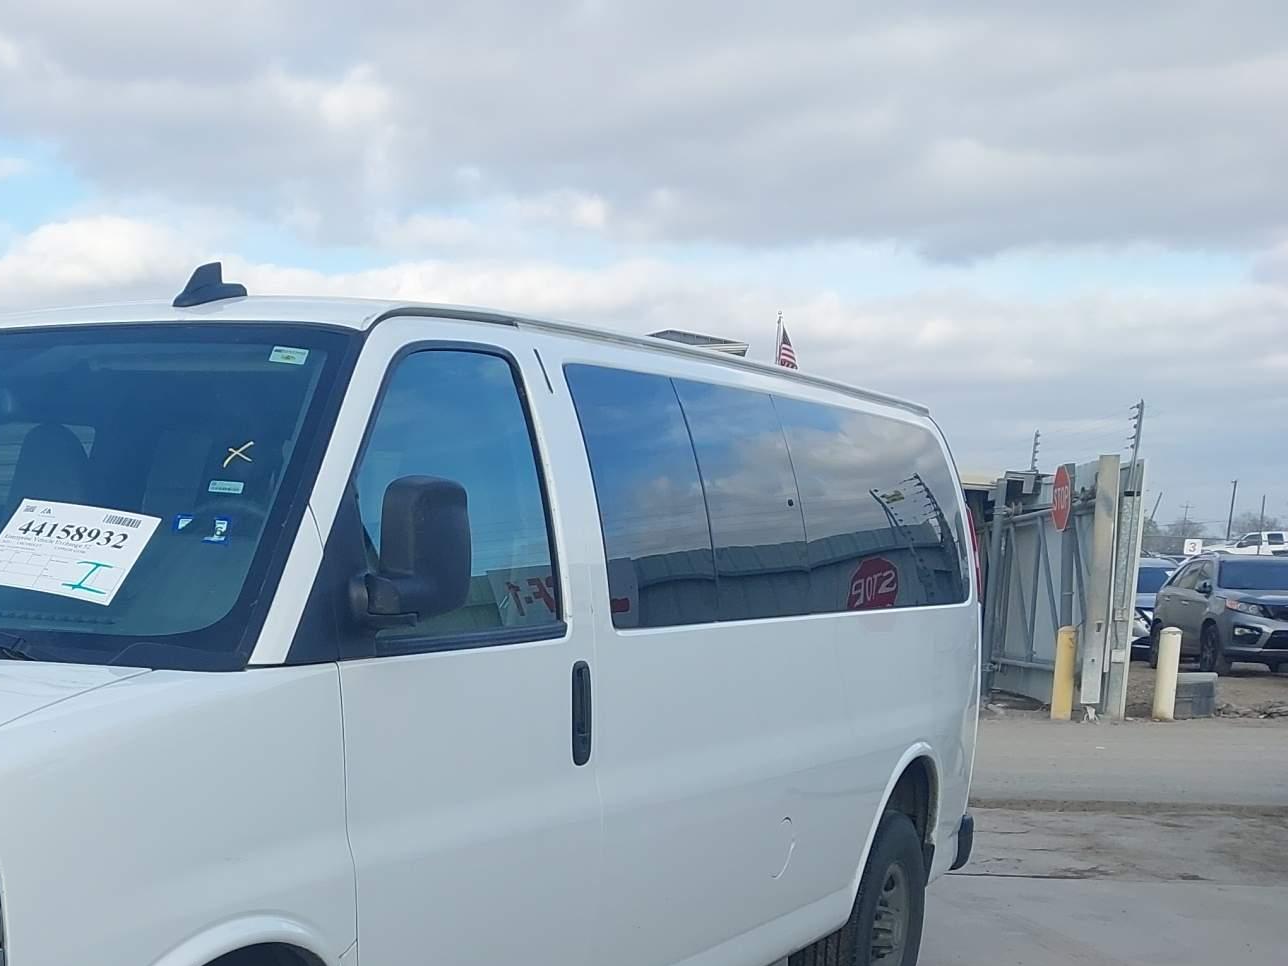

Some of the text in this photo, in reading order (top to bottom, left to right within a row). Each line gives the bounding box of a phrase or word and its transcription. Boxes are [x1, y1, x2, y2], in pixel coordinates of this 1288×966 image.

[1054, 486, 1068, 510] STOP
[18, 519, 128, 549] 44158932
[1189, 542, 1197, 553] 3
